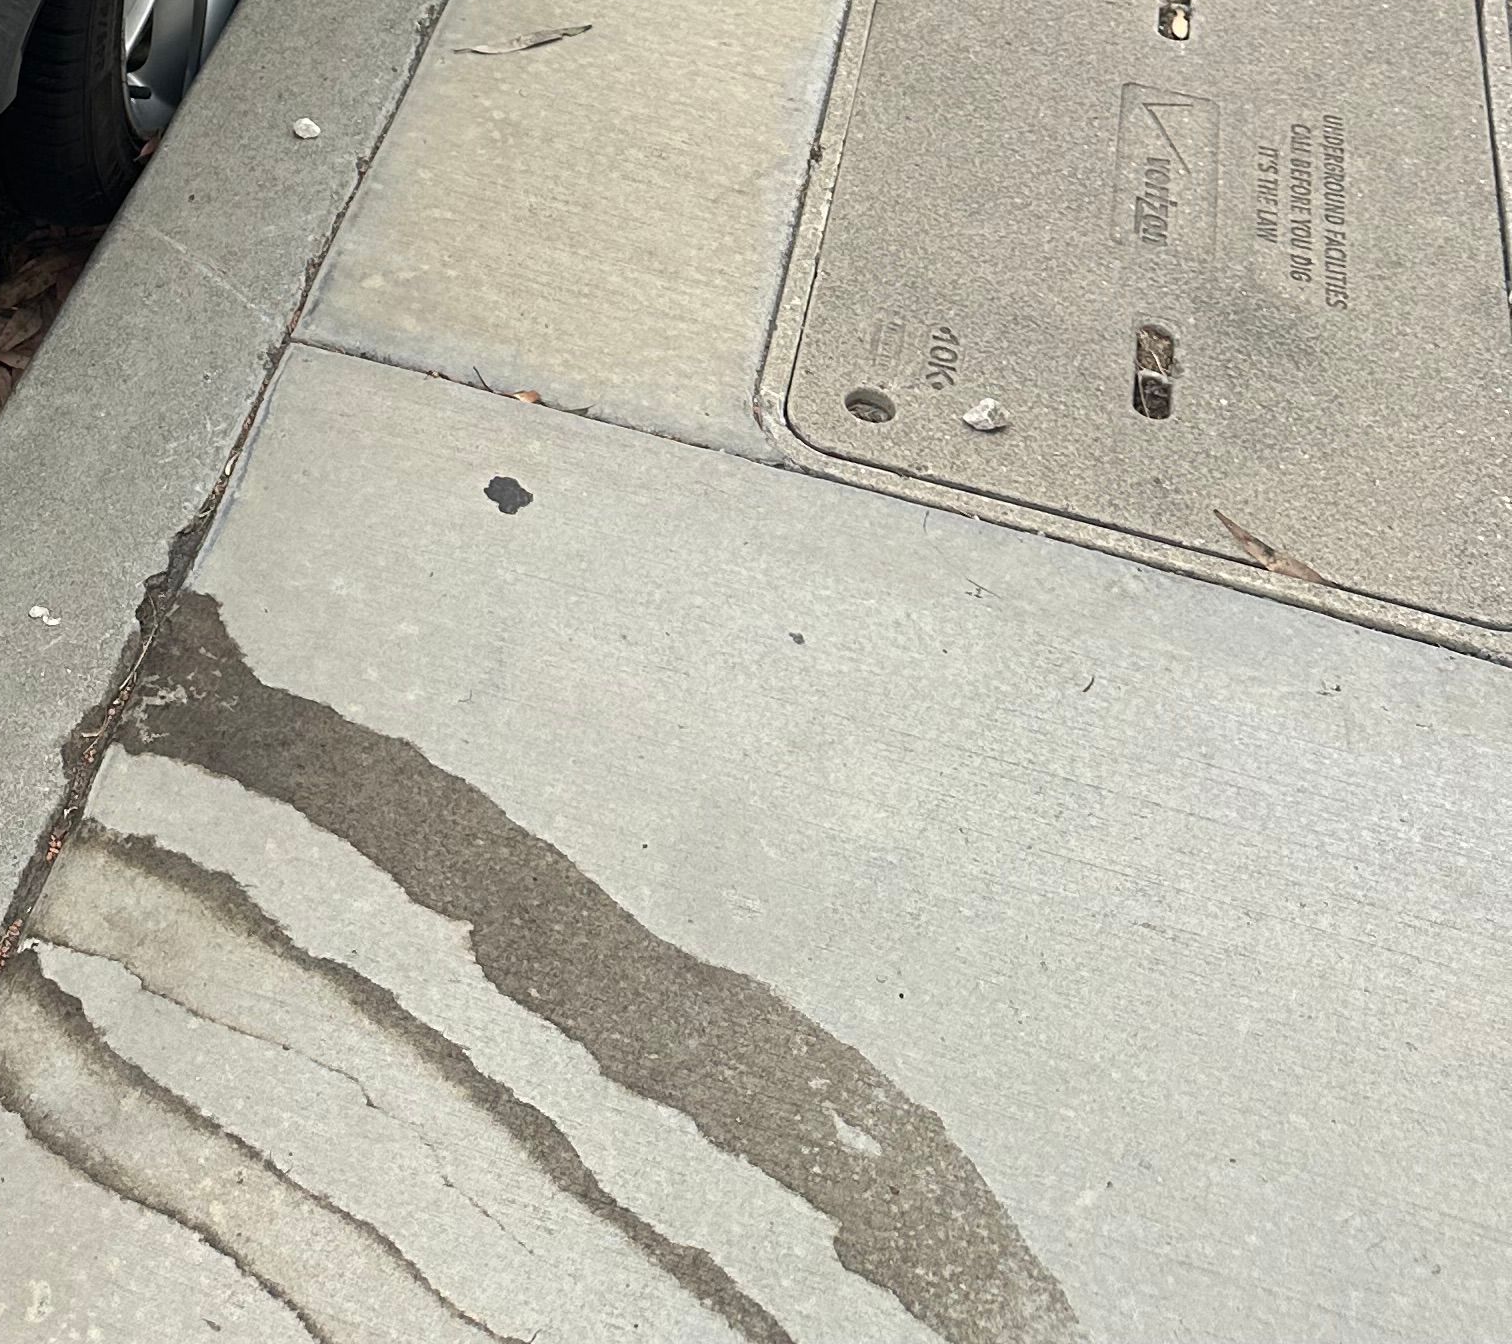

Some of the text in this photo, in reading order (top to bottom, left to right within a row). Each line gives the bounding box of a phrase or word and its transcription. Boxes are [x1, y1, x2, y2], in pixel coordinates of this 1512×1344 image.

[1134, 157, 1178, 246] verizon
[1256, 145, 1279, 244] IT'S THE LAW
[1290, 123, 1313, 283] CALL BEFORE YOU DIG
[1322, 114, 1349, 310] UNDERGROUND FACILITIES
